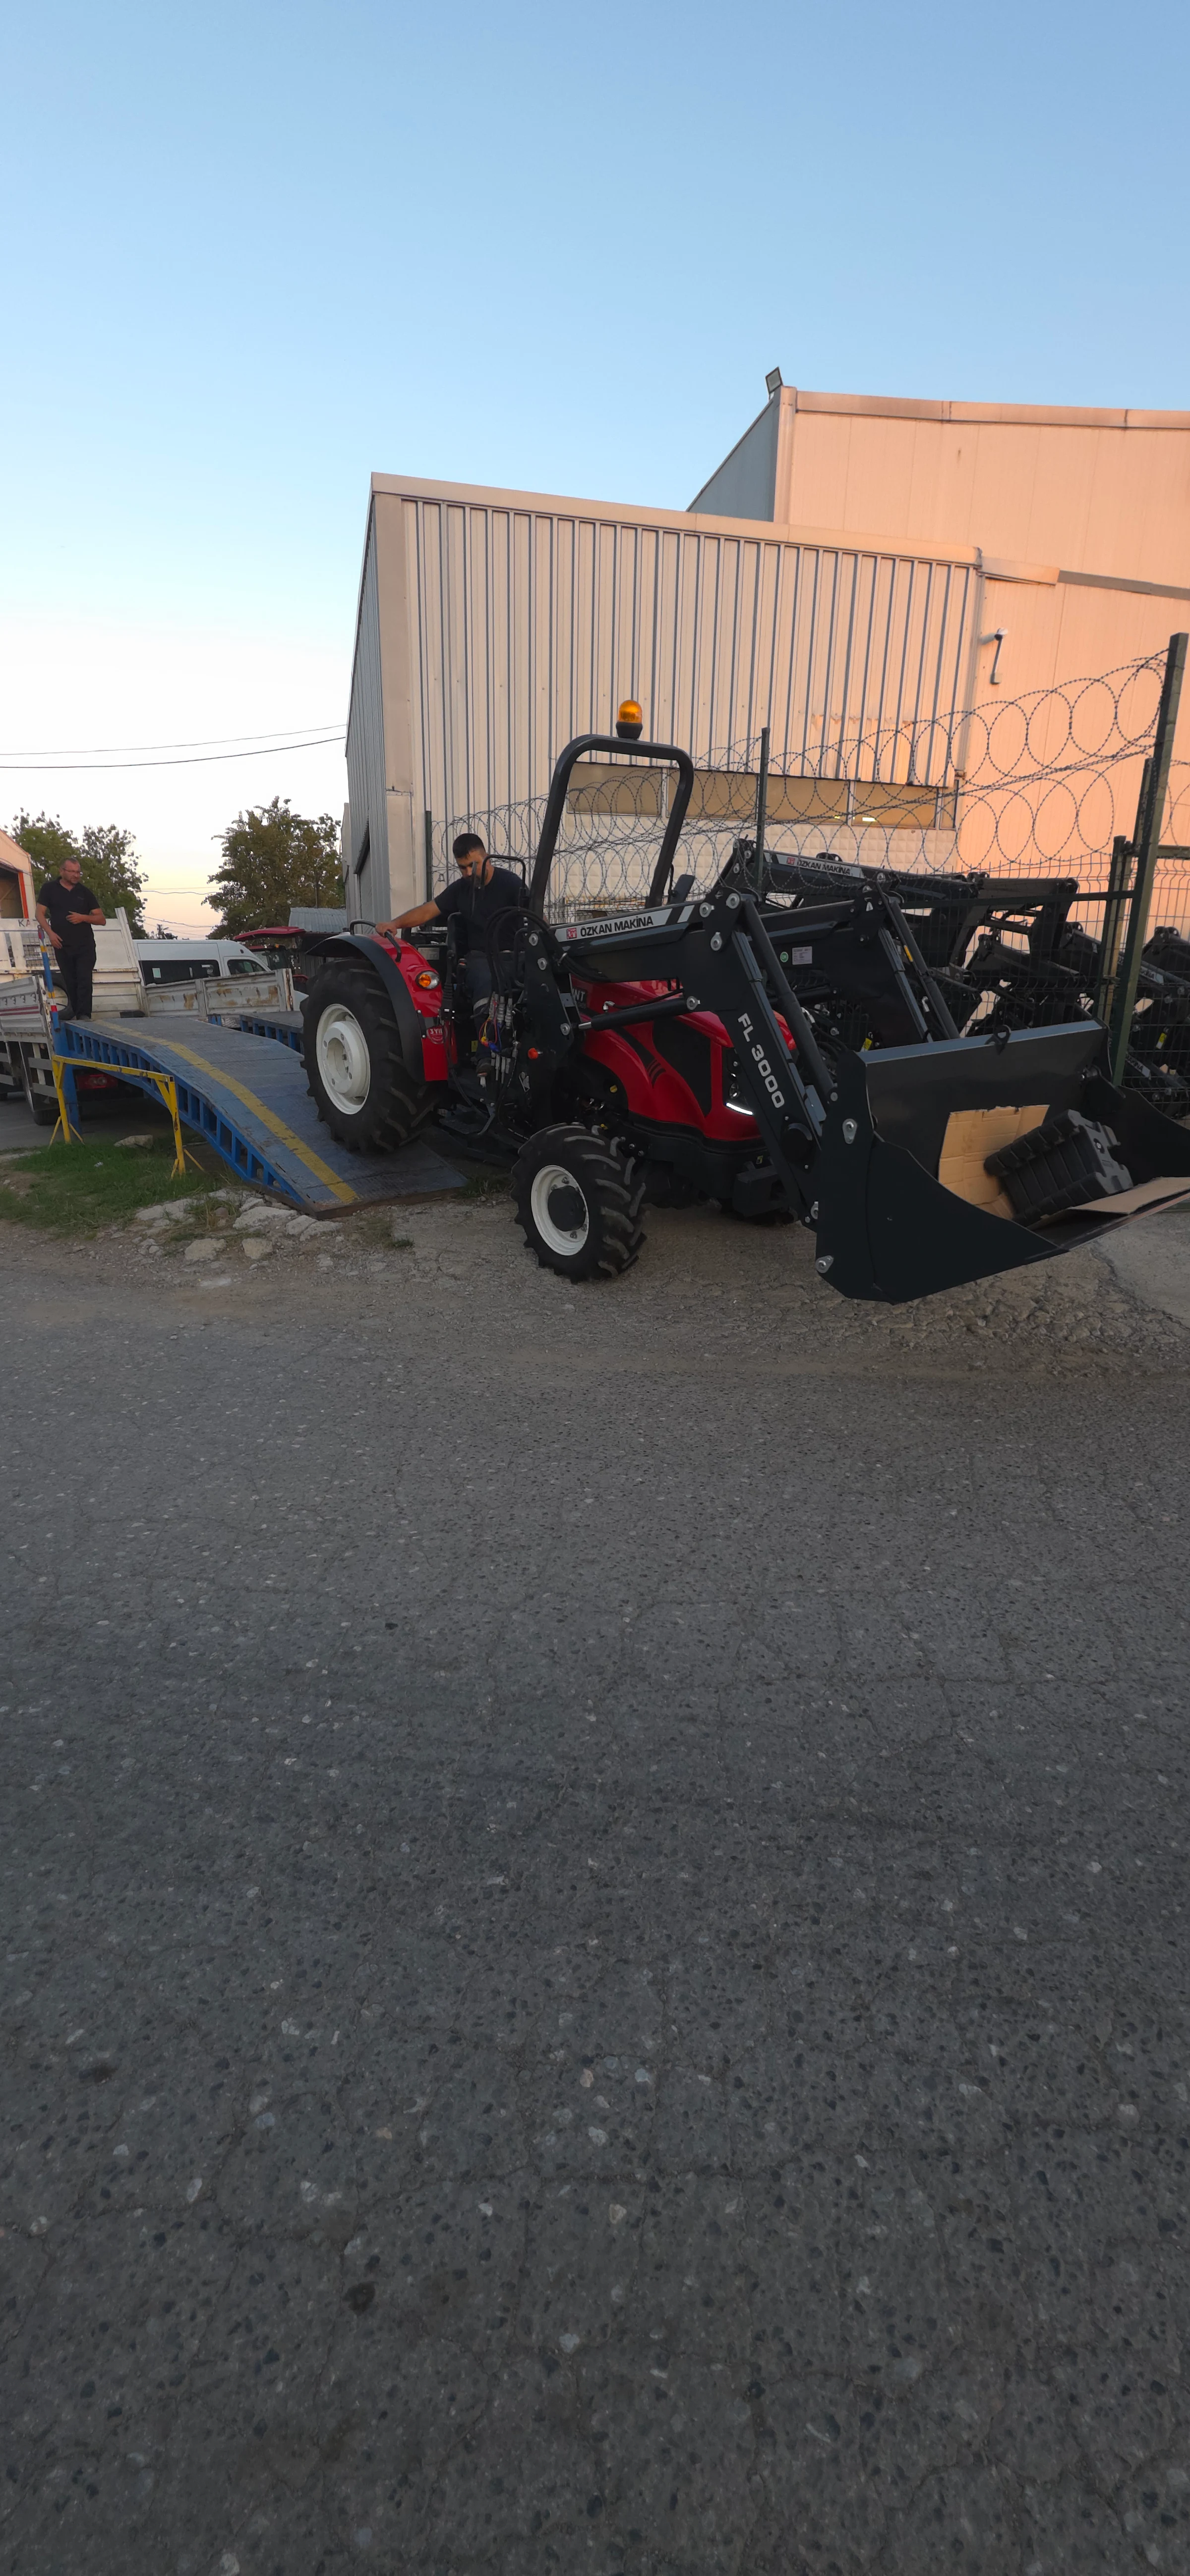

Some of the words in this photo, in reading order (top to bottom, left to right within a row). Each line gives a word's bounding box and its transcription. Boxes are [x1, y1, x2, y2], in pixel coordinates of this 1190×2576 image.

[580, 923, 612, 937] ÖZKAN
[614, 916, 654, 931] MAKİNA
[738, 1013, 754, 1042] FL
[751, 1044, 785, 1108] 3000
